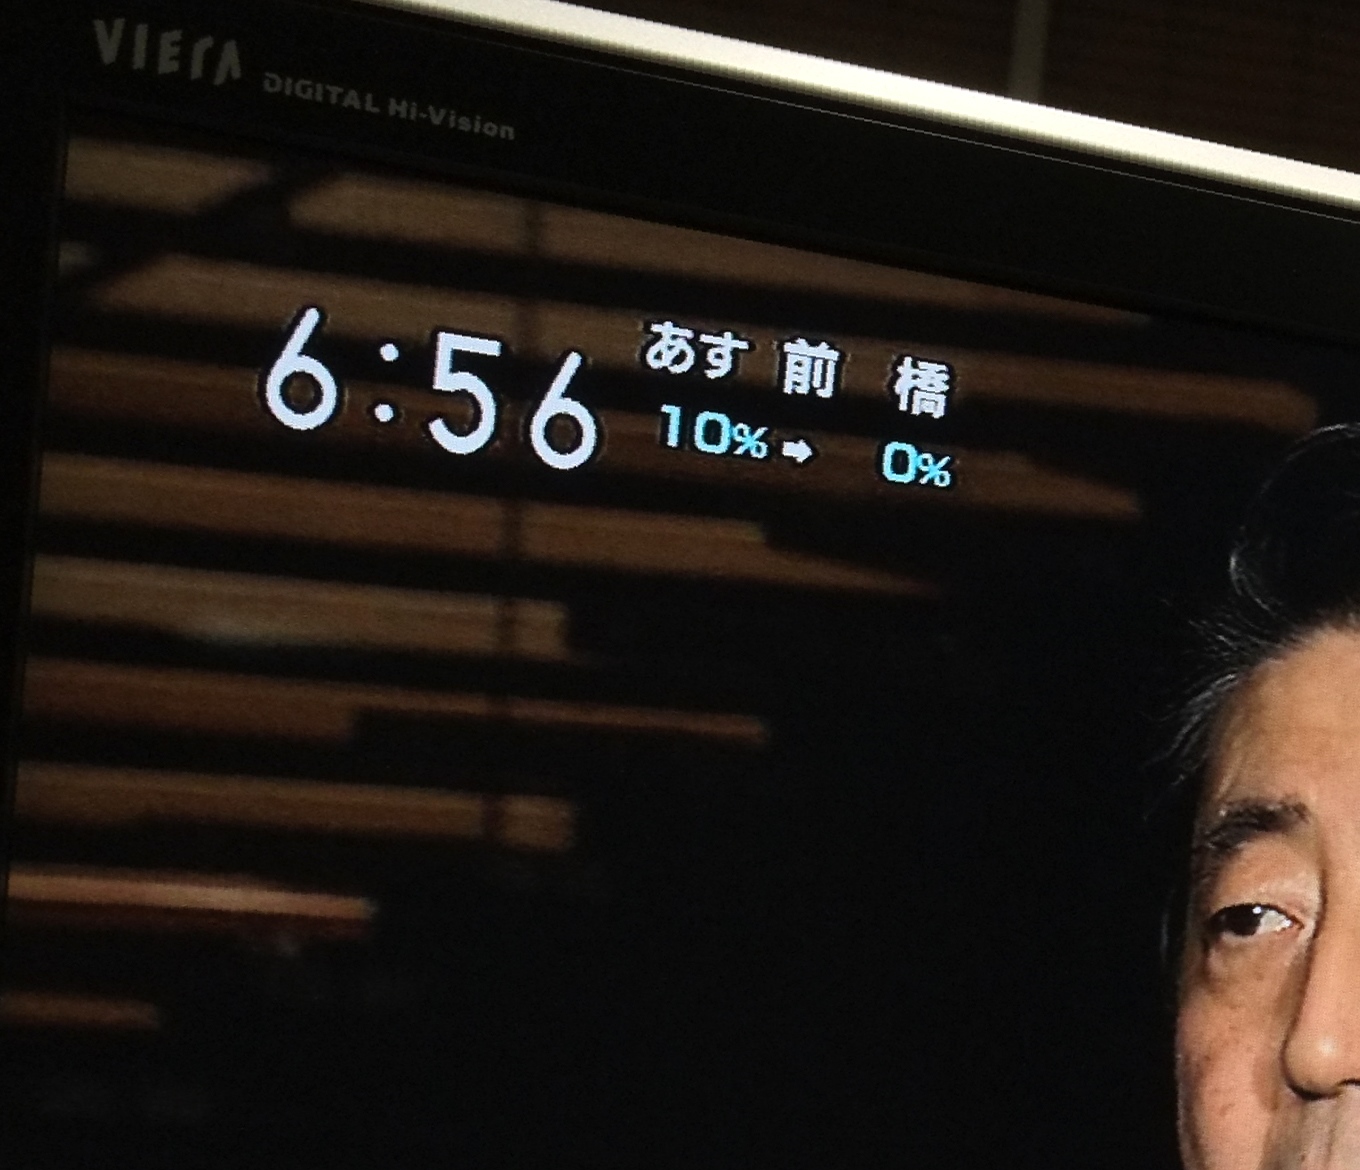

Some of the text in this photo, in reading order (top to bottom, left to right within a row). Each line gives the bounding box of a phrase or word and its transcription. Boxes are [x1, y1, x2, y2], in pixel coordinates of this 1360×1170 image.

[262, 71, 516, 142] DIGITAL Hi-Vision
[265, 306, 598, 471] 6:56
[646, 321, 749, 380] あす
[660, 404, 952, 488] 10% 0%
